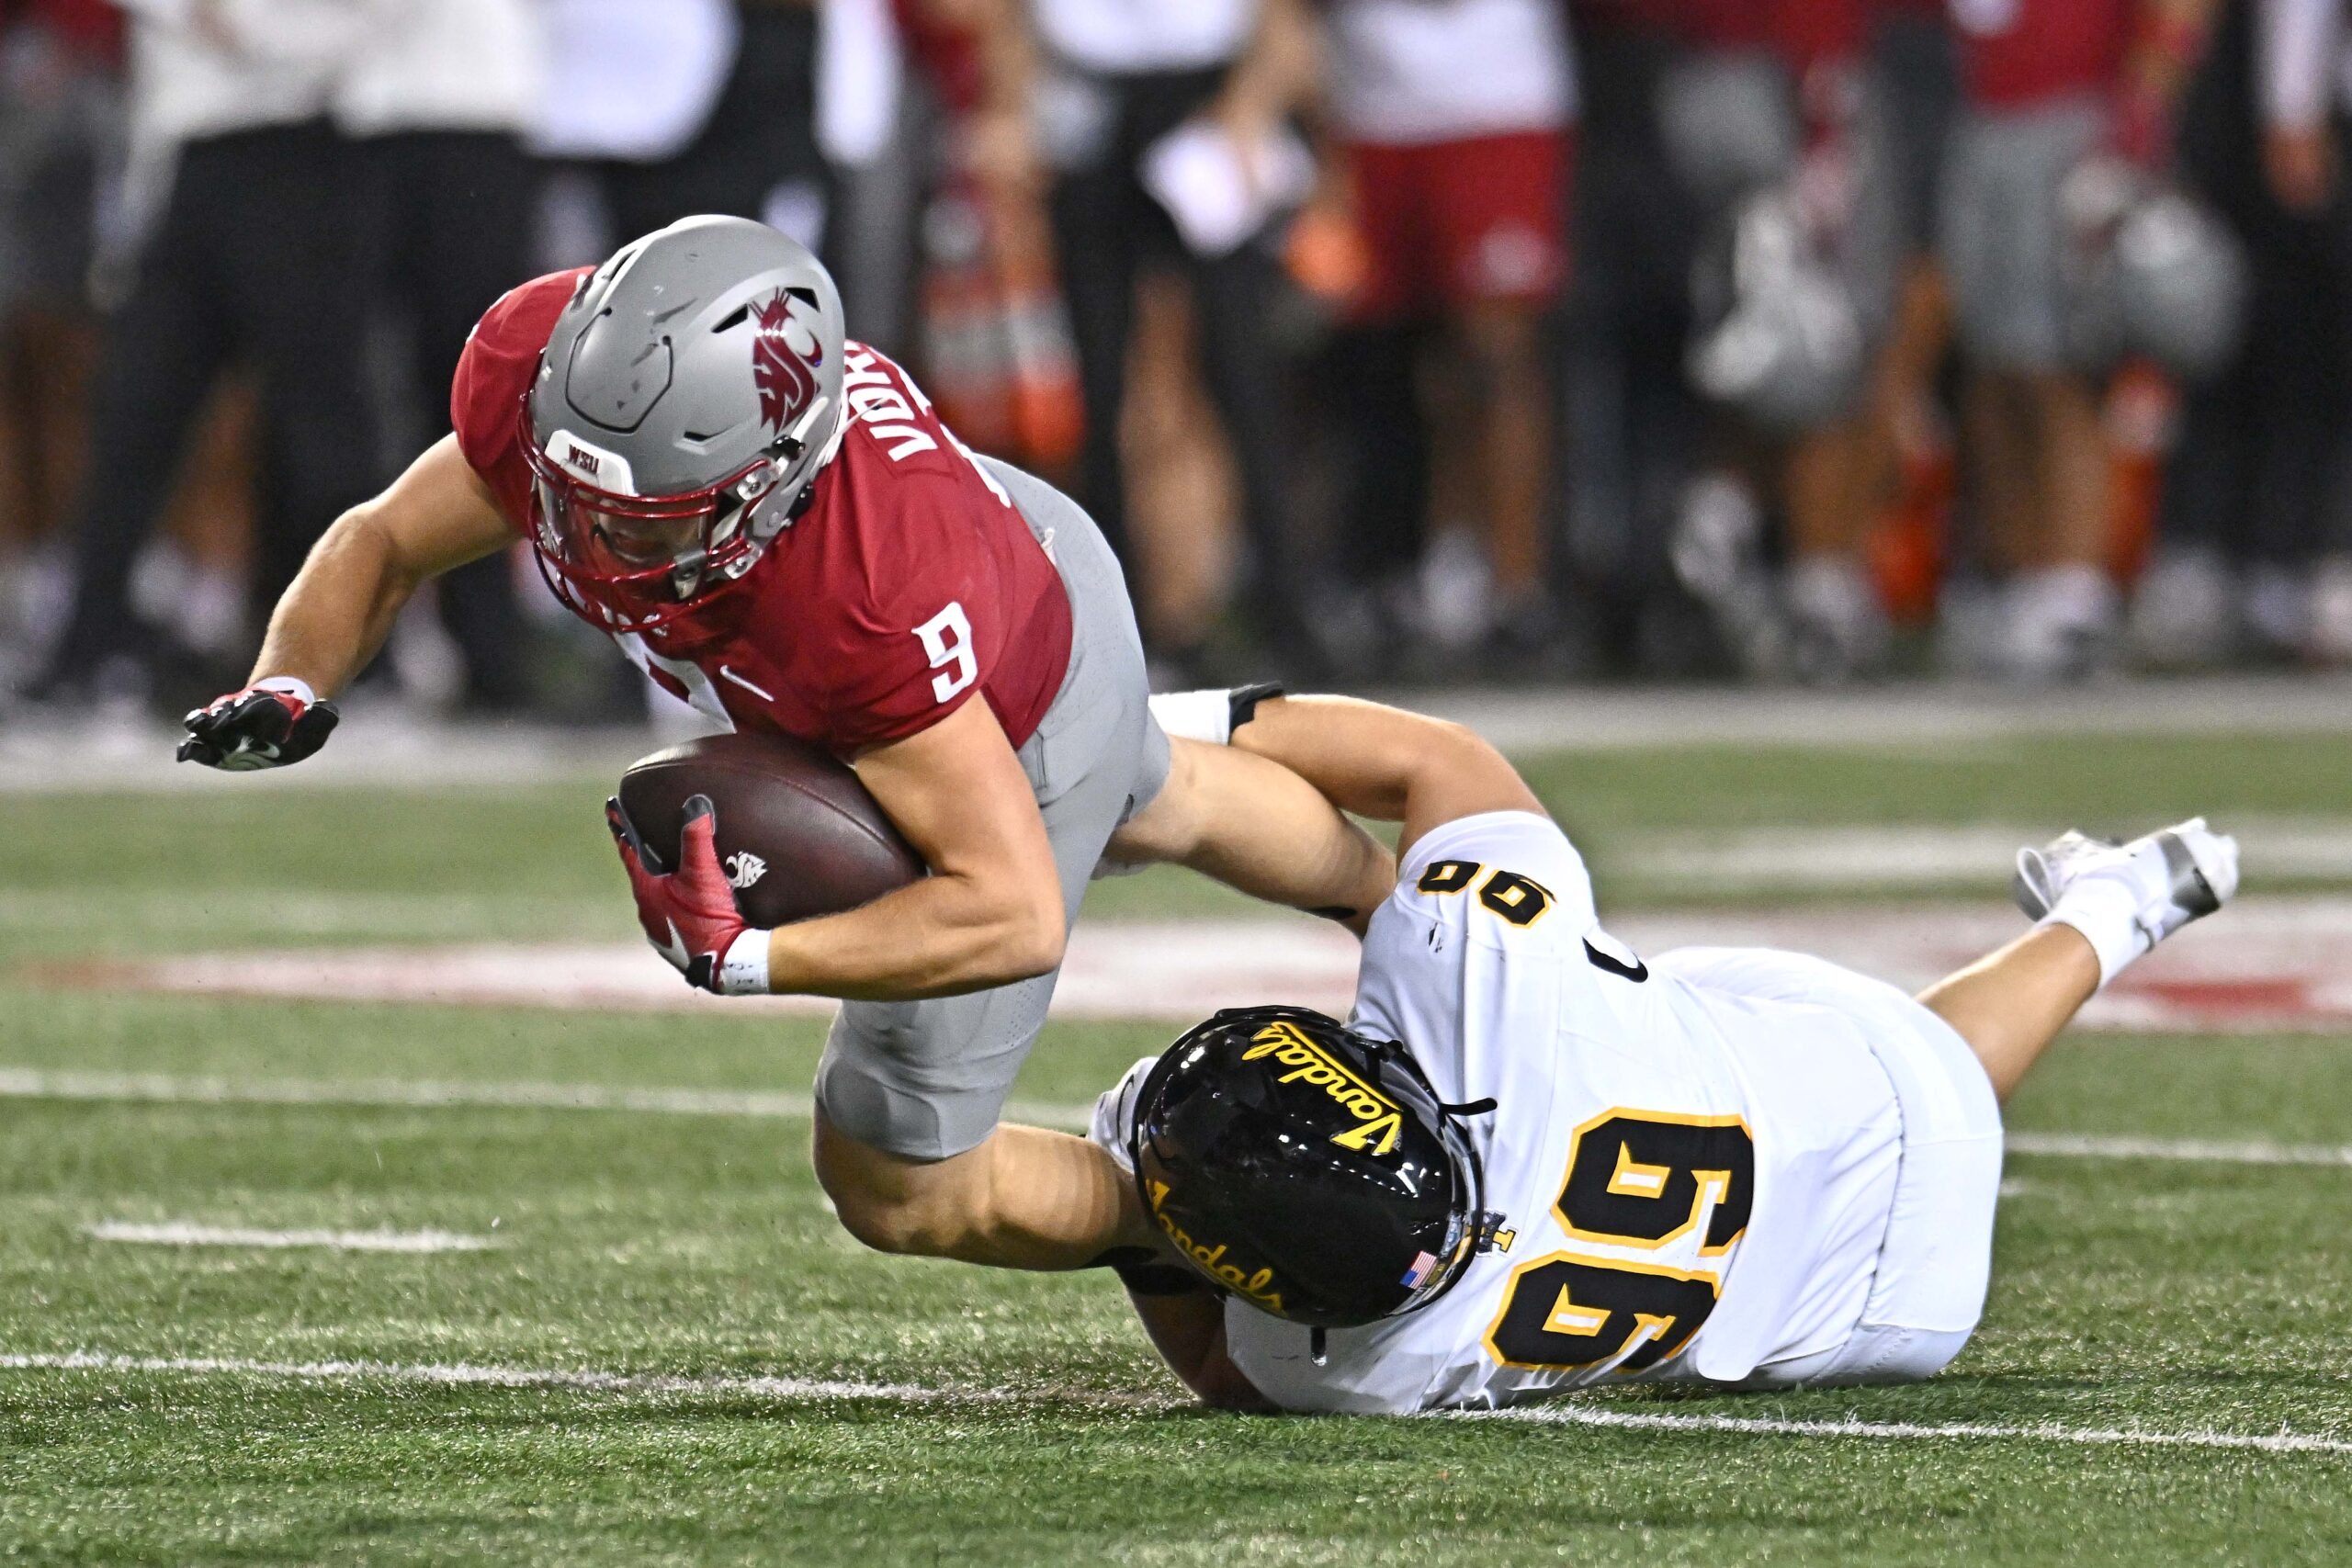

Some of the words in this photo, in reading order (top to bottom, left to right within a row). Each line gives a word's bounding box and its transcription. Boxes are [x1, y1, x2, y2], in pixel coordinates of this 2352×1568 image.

[569, 444, 600, 475] WSU
[842, 340, 939, 462] VOR
[910, 601, 978, 705] 9
[1241, 1021, 1405, 1156] Vandals
[1481, 1105, 1756, 1372] 99
